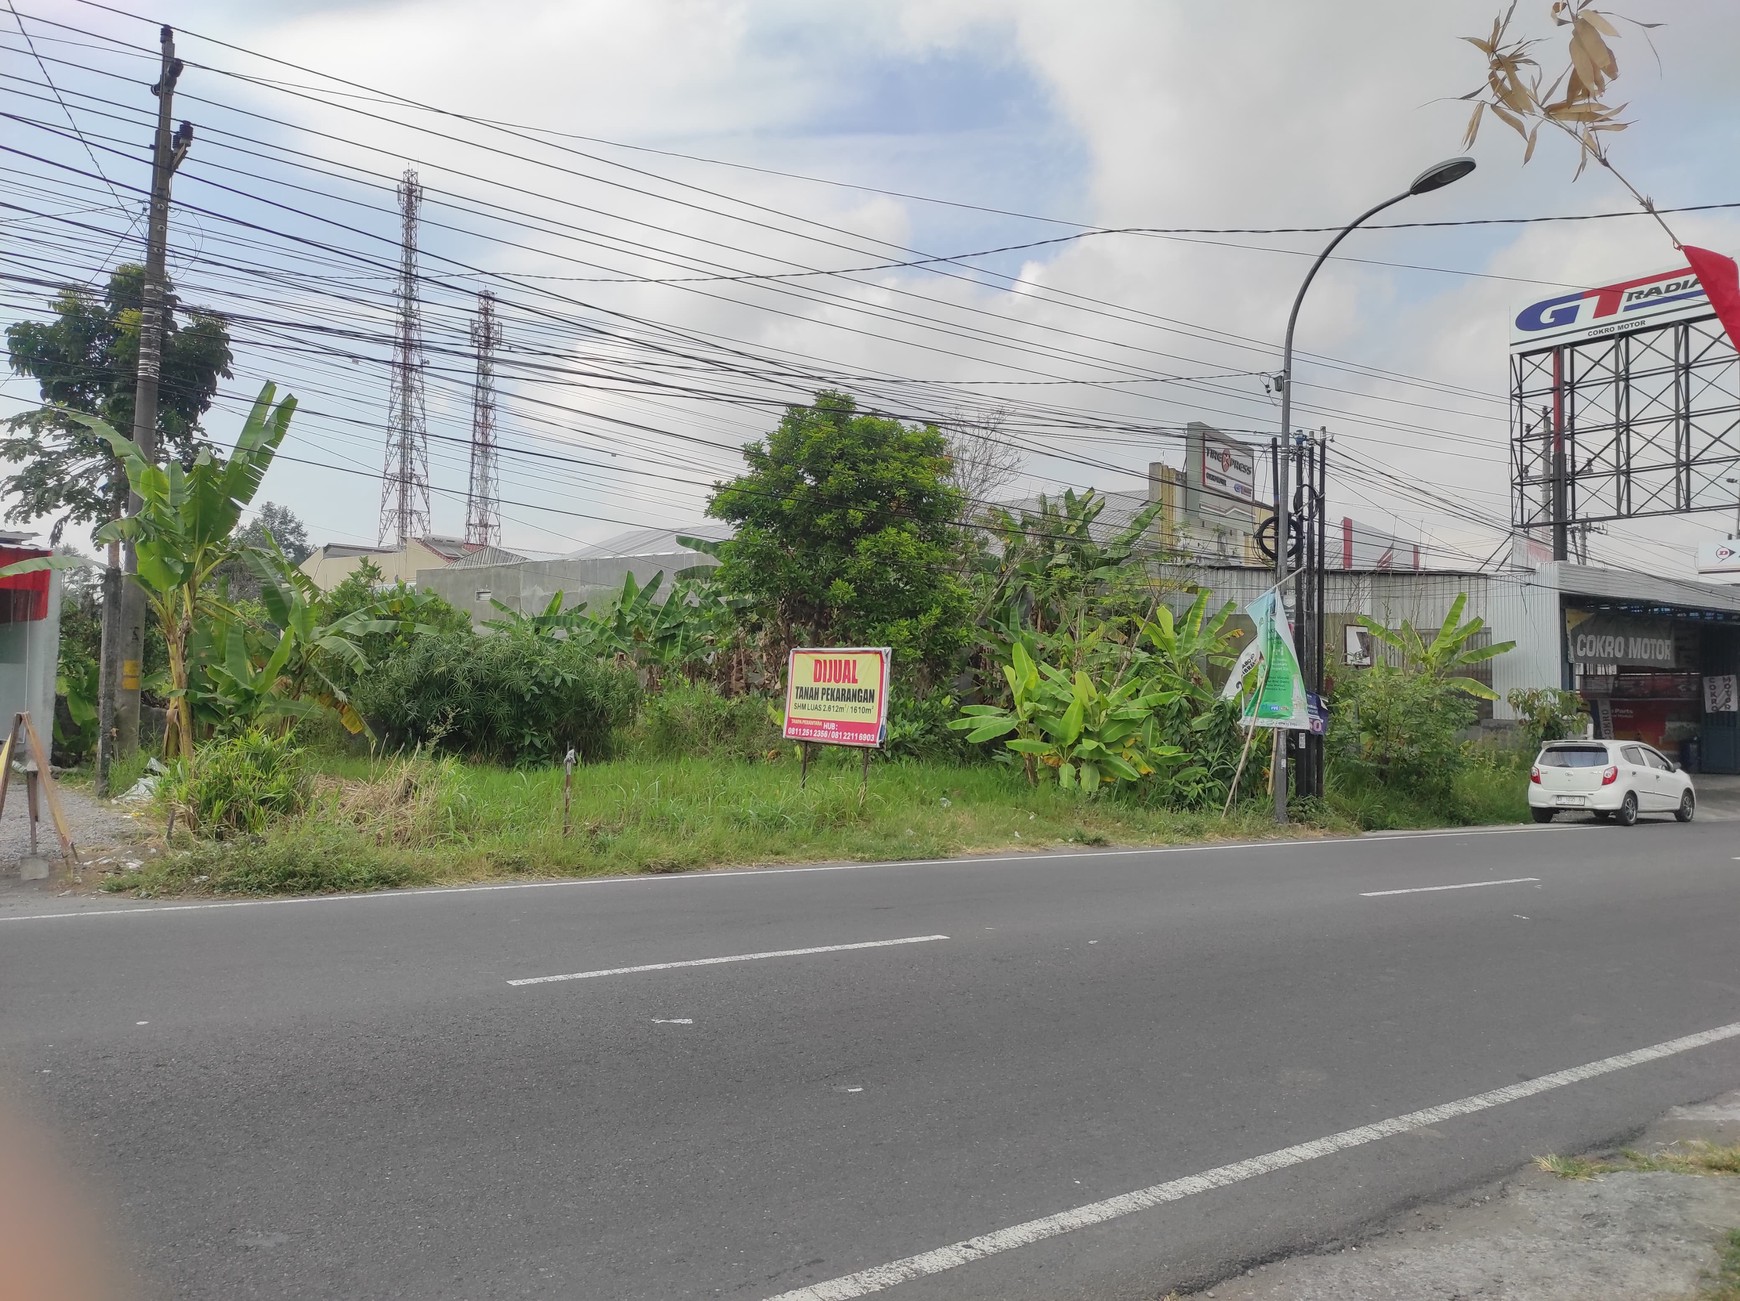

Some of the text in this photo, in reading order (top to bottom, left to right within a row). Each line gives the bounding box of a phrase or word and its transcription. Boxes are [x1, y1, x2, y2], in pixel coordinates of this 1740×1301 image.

[1515, 285, 1625, 331] GT
[1588, 319, 1646, 337] COKRO MOTOR
[1576, 634, 1672, 661] COKRO MOTOR
[813, 659, 858, 684] DIJUAL
[795, 686, 875, 703] TANAH PEKARANGAN
[807, 703, 822, 711] LUAS
[1708, 677, 1719, 712] COKRO
